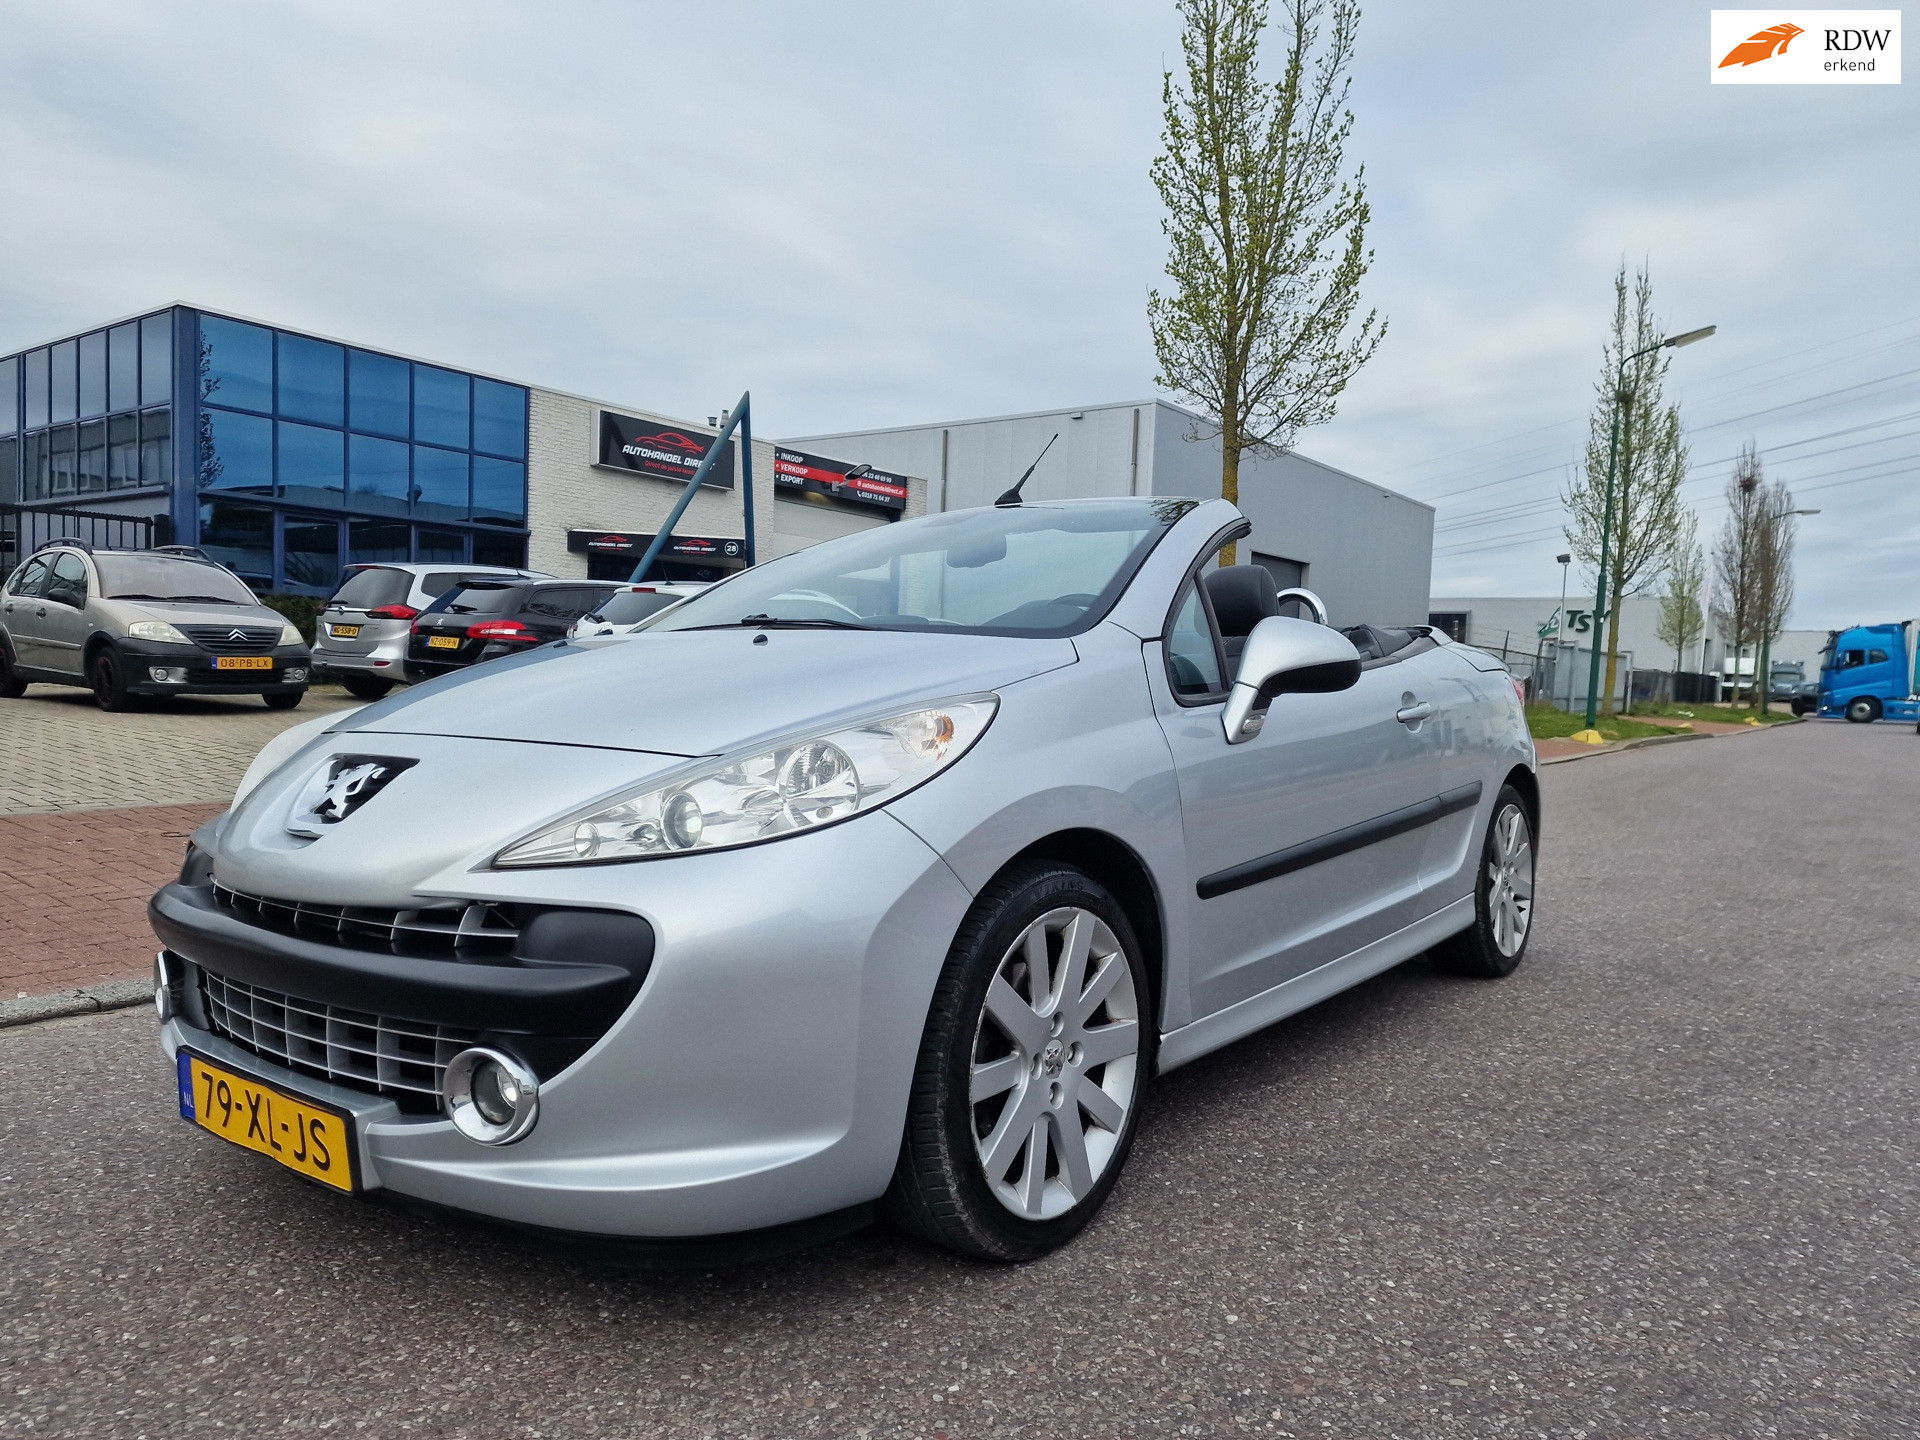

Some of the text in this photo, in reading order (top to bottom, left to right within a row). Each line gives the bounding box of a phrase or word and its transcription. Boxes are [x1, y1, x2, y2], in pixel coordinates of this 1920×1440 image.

[622, 444, 682, 465] AUTOHANDEL
[780, 452, 804, 464] INKOOP
[780, 463, 809, 475] VERKOOP
[780, 473, 804, 486] EXPORT
[1566, 610, 1612, 633] TS
[220, 658, 269, 668] 08-PB-LX
[183, 1091, 194, 1109] NL
[201, 1071, 331, 1172] 79-XL-JS
